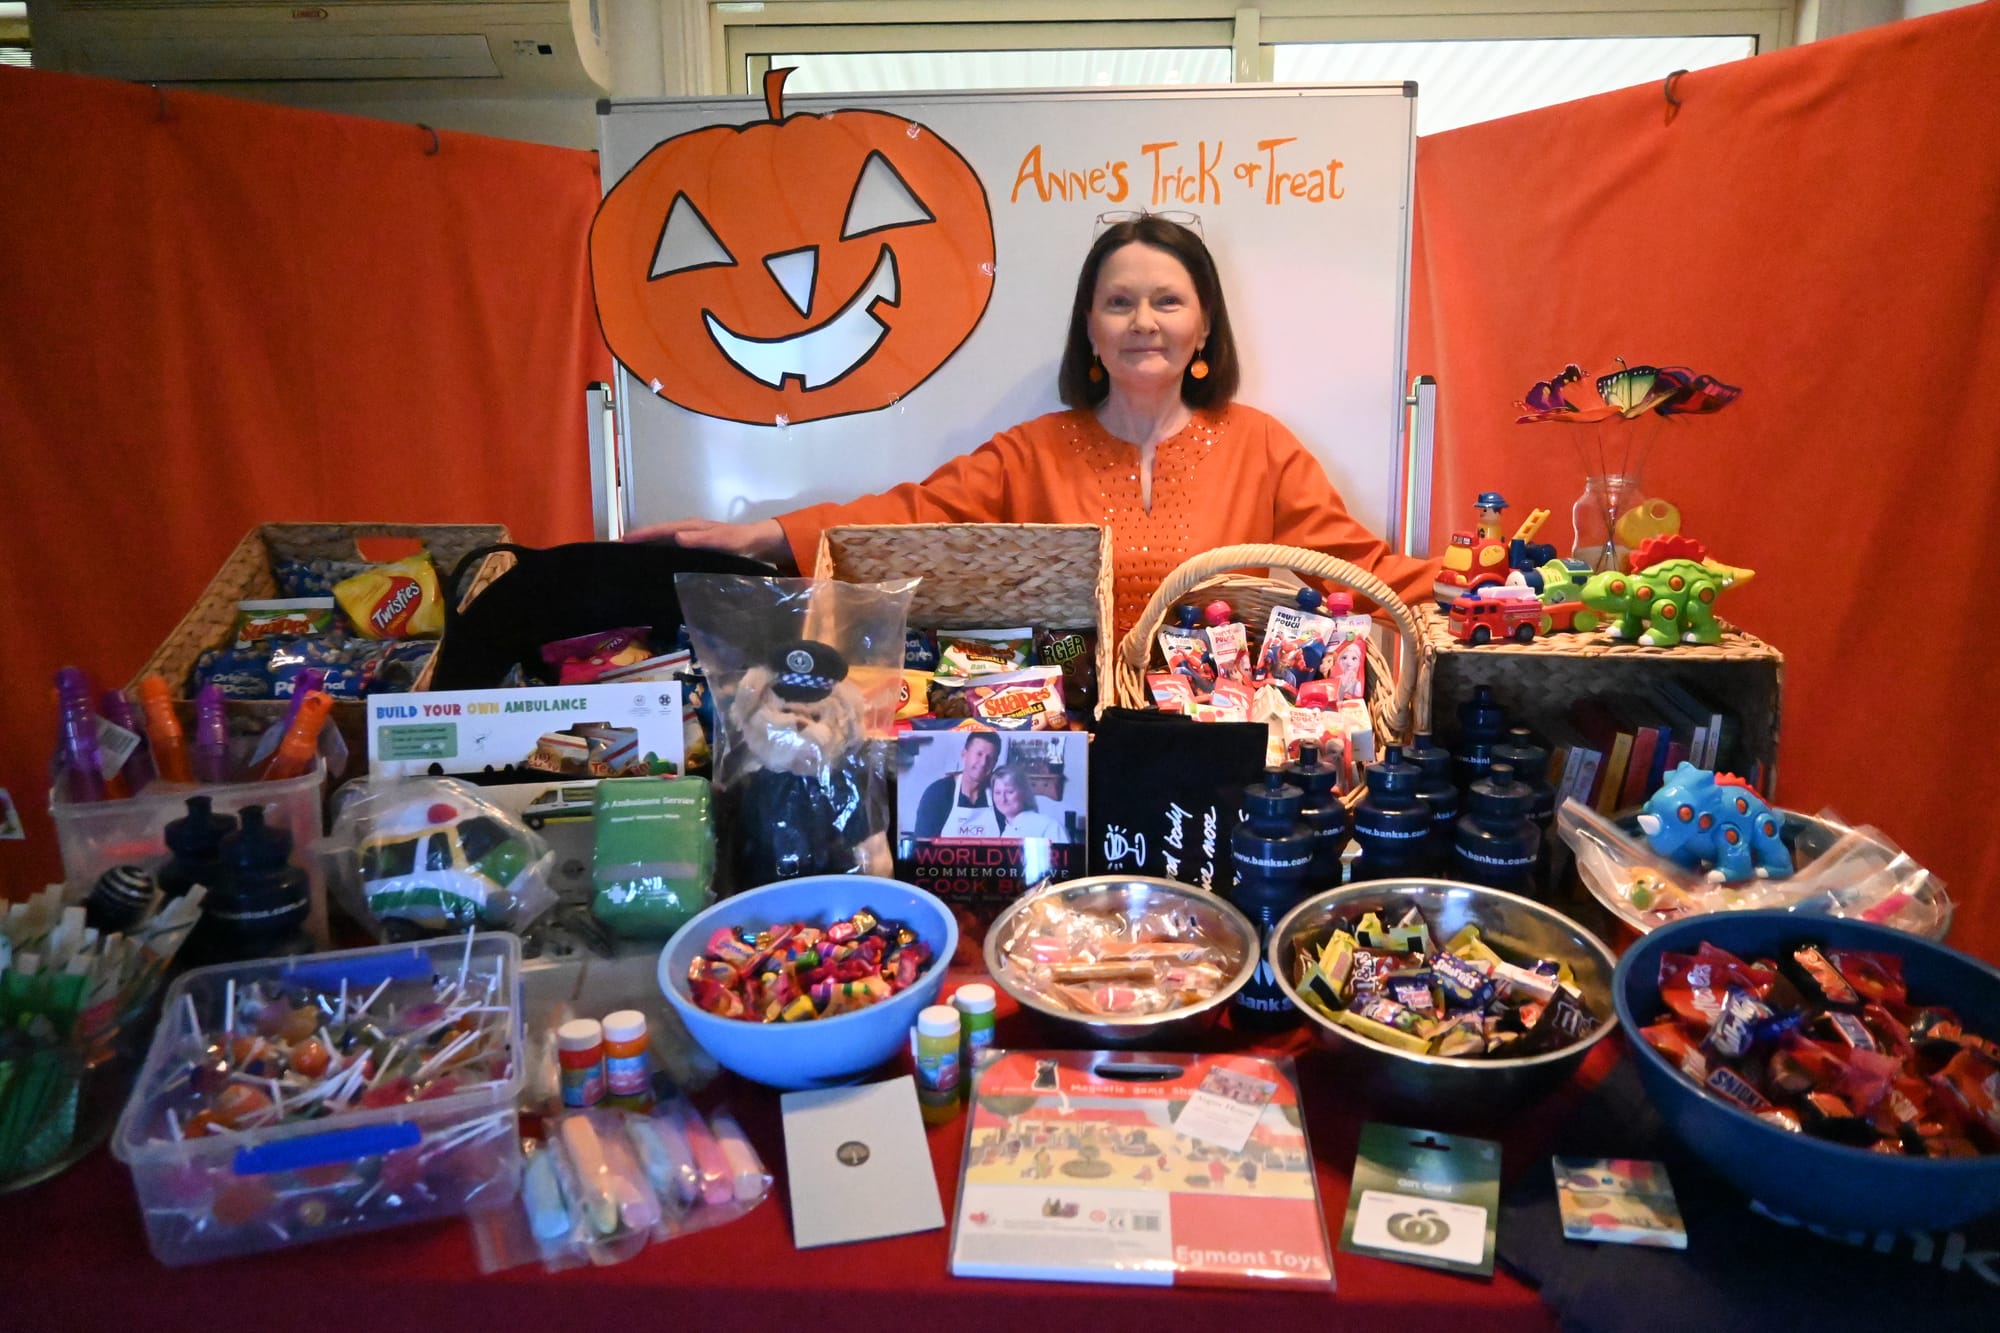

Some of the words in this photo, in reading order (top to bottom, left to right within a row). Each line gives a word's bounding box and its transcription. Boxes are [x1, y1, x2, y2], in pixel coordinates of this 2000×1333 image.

[1234, 162, 1262, 188] or
[1257, 137, 1345, 205] Treat
[371, 582, 420, 629] Twisties
[376, 706, 418, 719] BUILD
[423, 703, 462, 717] YOUR
[467, 702, 500, 715] OWN
[504, 698, 588, 713] AMBULANCE
[916, 848, 1004, 867] WORLD
[916, 879, 987, 894] COOK
[1397, 1178, 1421, 1189] Gift
[1422, 1182, 1453, 1194] Card
[1175, 1245, 1266, 1271] Egmont
[1270, 1249, 1324, 1272] Toys
